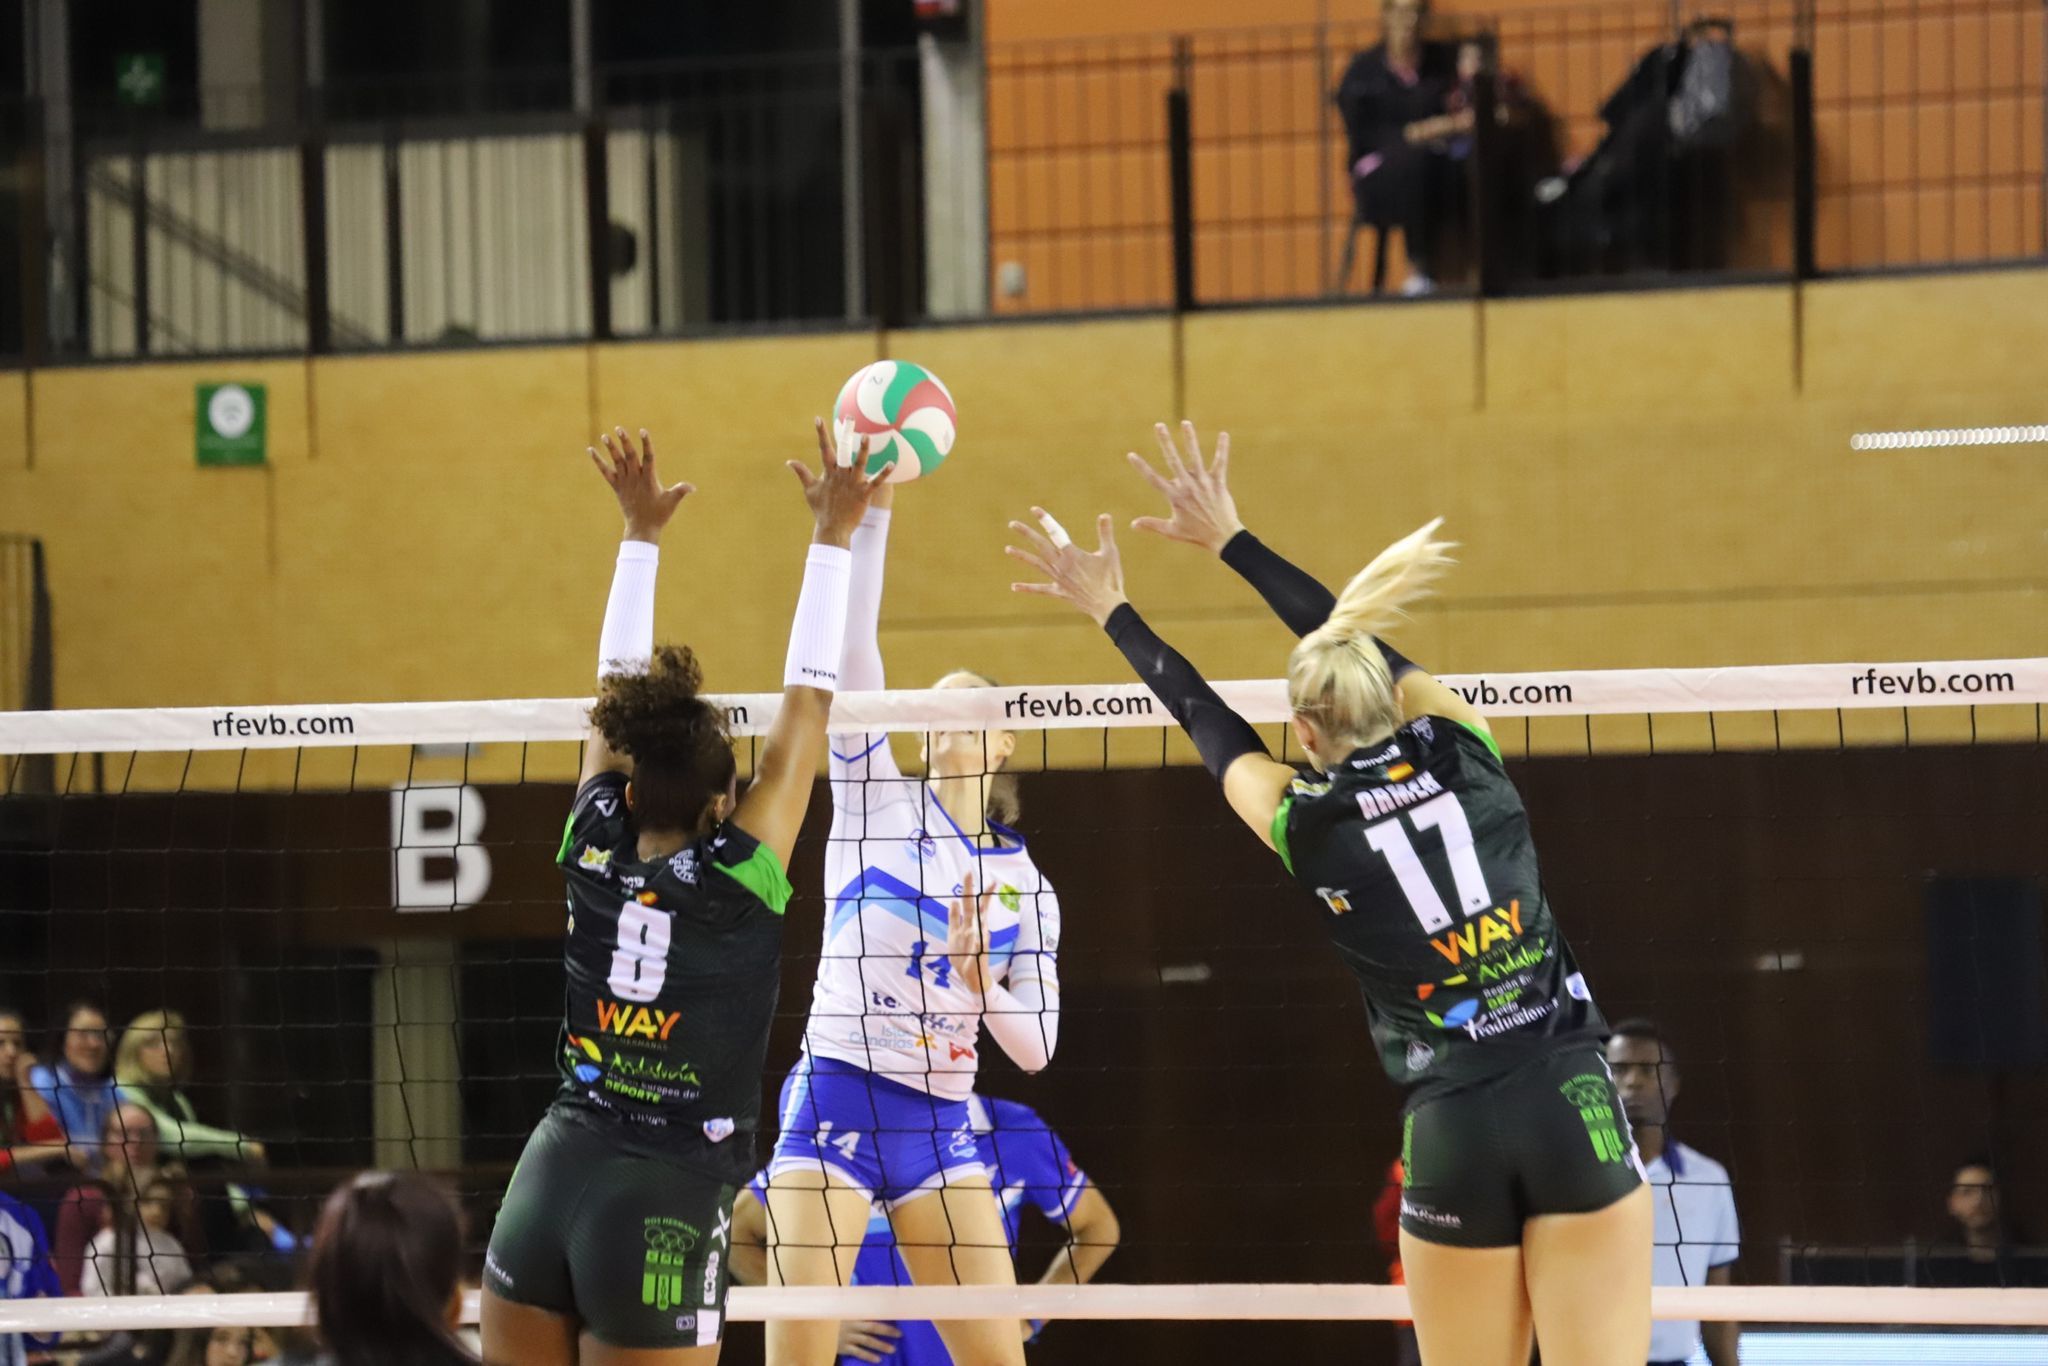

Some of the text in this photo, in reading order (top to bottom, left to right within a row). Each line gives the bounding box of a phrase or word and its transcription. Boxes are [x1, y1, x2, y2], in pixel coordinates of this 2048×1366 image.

[1448, 680, 1573, 705] vb.com
[1851, 667, 2016, 695] rfevb.com
[211, 711, 355, 738] rfevb.com
[1004, 691, 1154, 718] rfevb.com
[390, 782, 492, 913] B
[1363, 790, 1492, 936] 17
[607, 900, 672, 1003] 8
[1430, 899, 1524, 966] WAY
[905, 940, 953, 989] 14
[597, 998, 681, 1041] WAY
[605, 1078, 662, 1105] DEPORTE
[810, 1121, 861, 1160] 14
